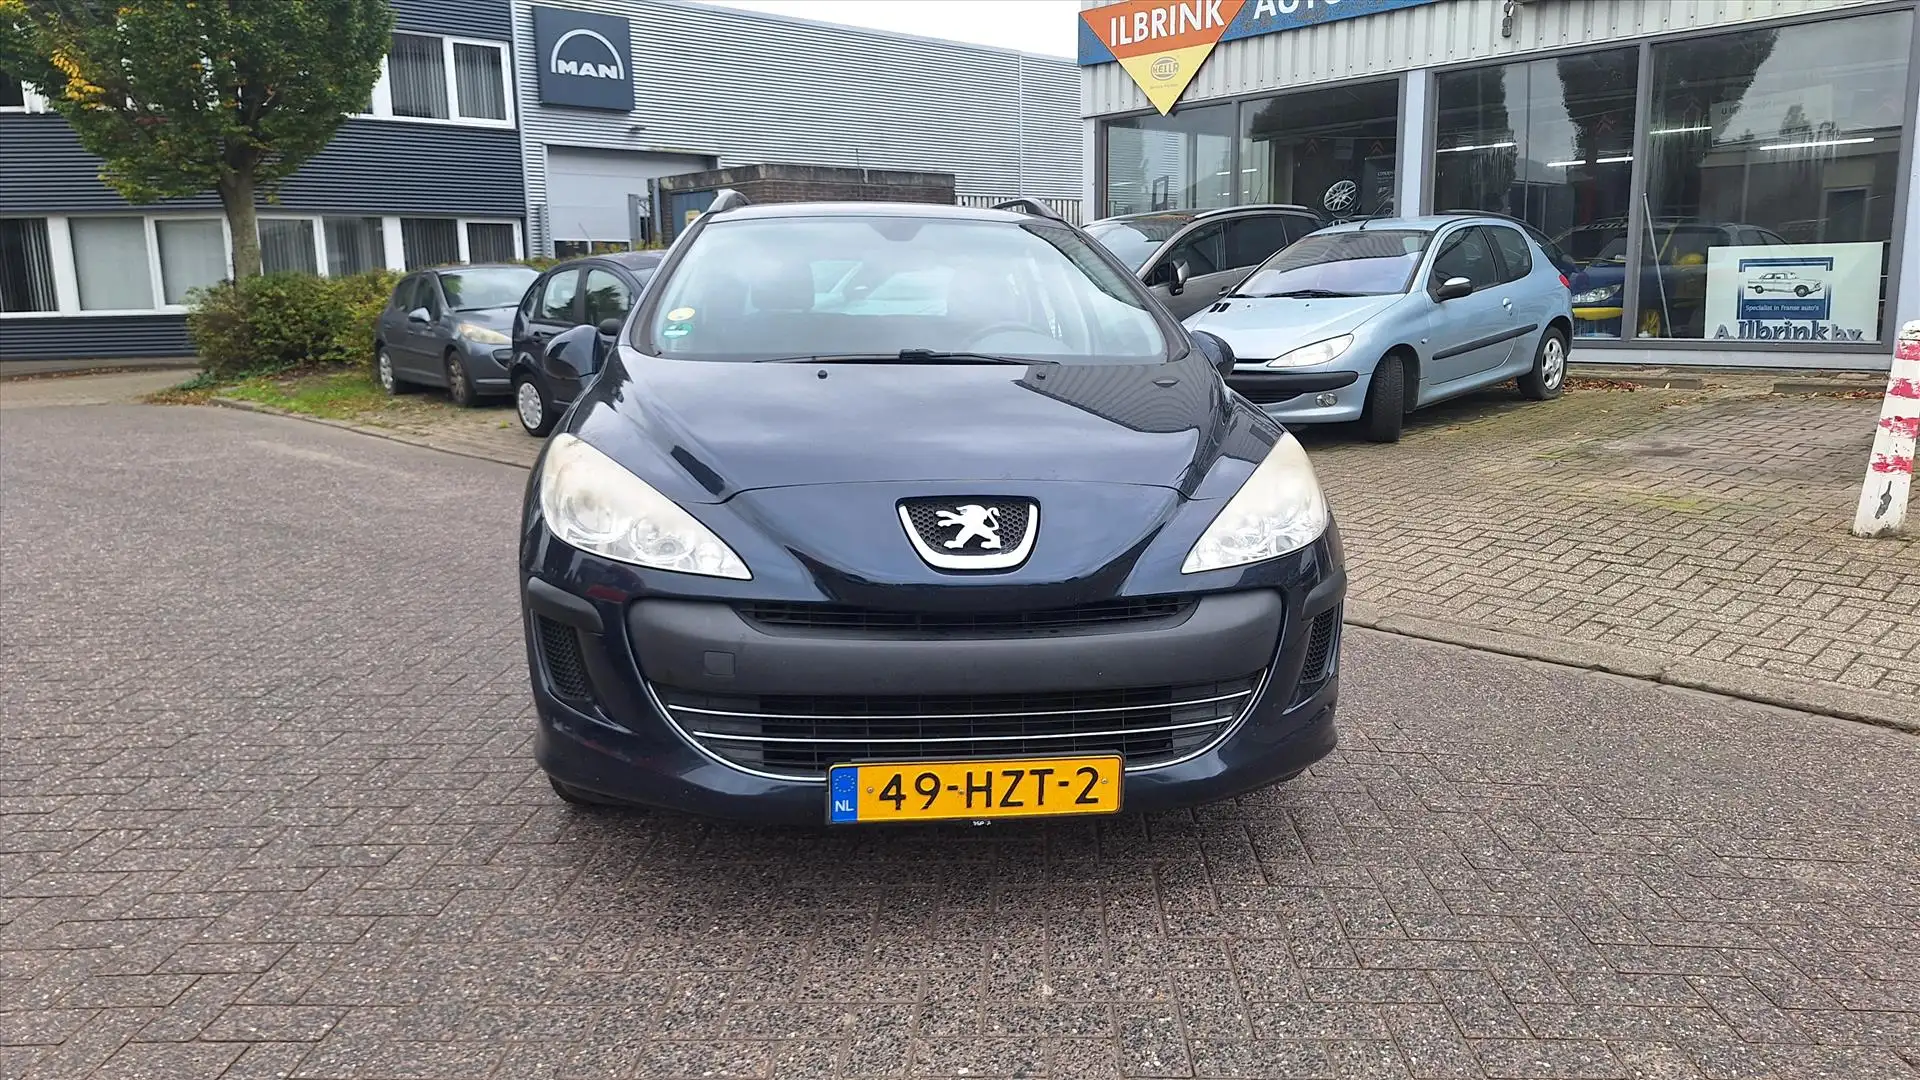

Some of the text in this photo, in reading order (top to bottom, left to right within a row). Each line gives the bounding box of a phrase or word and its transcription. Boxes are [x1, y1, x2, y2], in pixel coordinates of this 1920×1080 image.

[1253, 0, 1342, 20] AU
[1110, 0, 1225, 47] ILBRINK
[557, 59, 618, 80] MAN
[1738, 319, 1829, 341] Ilbrink
[879, 766, 1099, 811] 49-HZT-2
[835, 800, 853, 812] NL
